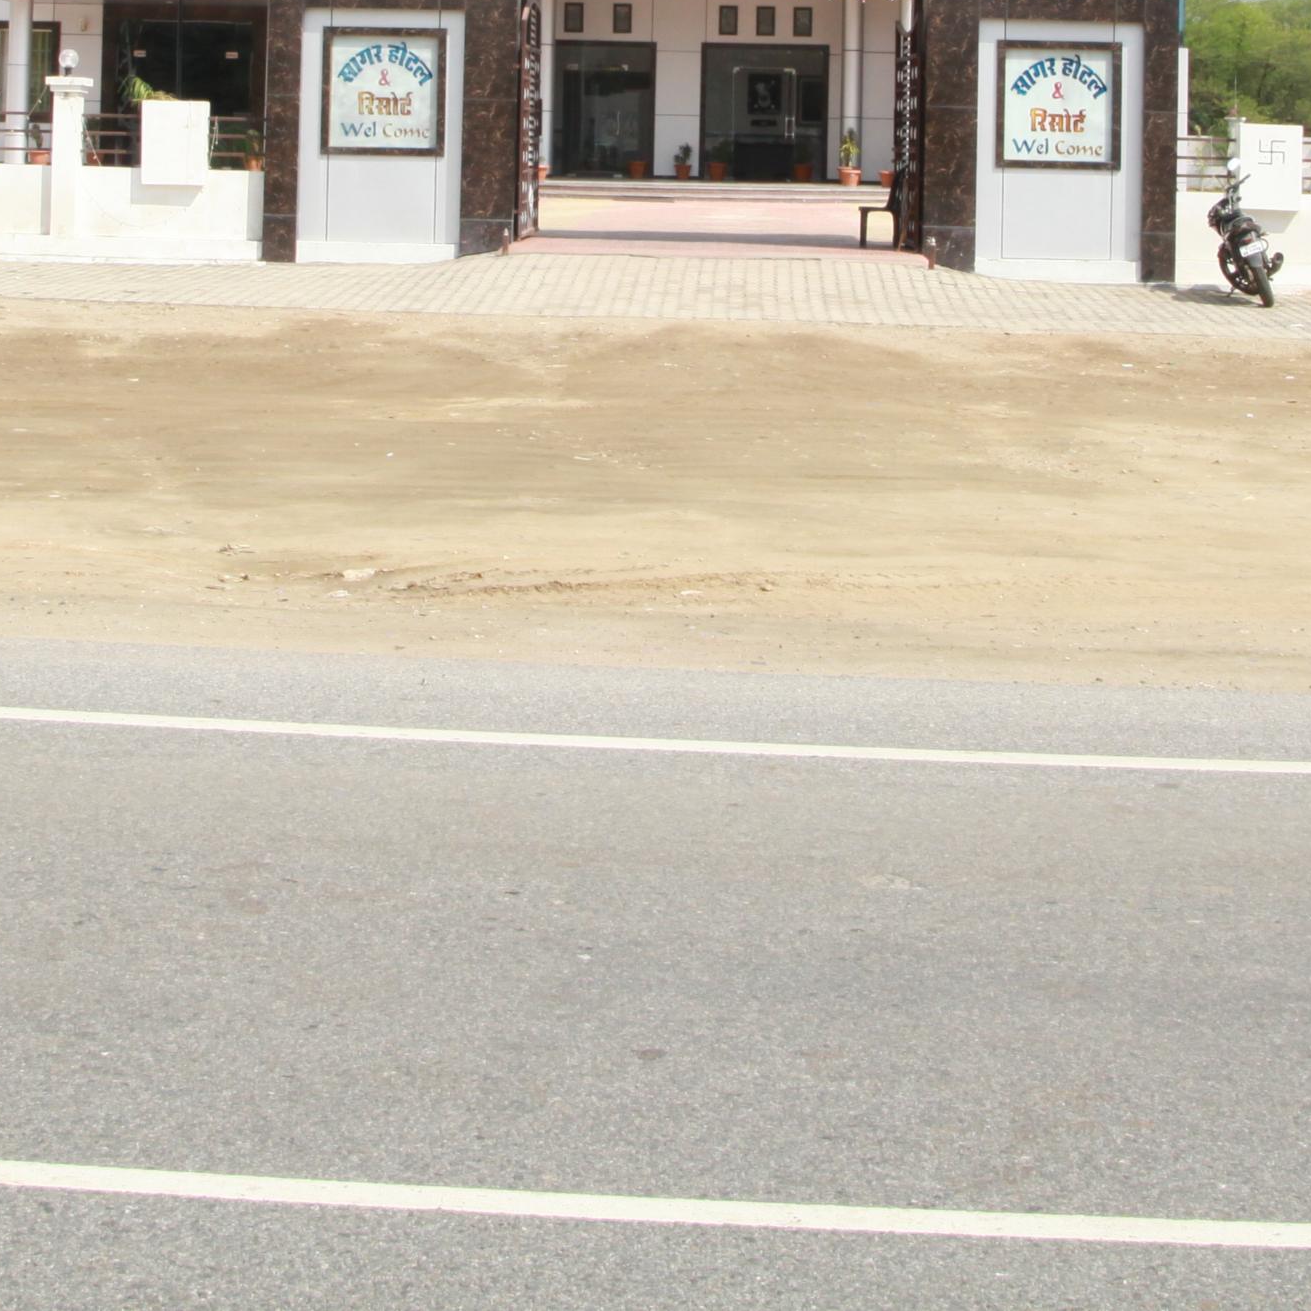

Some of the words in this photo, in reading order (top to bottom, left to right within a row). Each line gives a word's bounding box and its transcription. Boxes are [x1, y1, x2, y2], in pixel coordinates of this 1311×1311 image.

[338, 44, 383, 82] सागर
[387, 42, 433, 86] होटल
[378, 69, 390, 86] &
[1010, 57, 1056, 95] सागर
[1061, 54, 1107, 99] होटल
[1052, 81, 1064, 99] &
[357, 91, 413, 116] रिसोर्ट
[340, 122, 377, 138] Wel
[382, 123, 430, 138] Come
[1029, 108, 1086, 133] रिसोर्ट
[1012, 138, 1049, 154] Wel
[1055, 140, 1103, 156] Come
